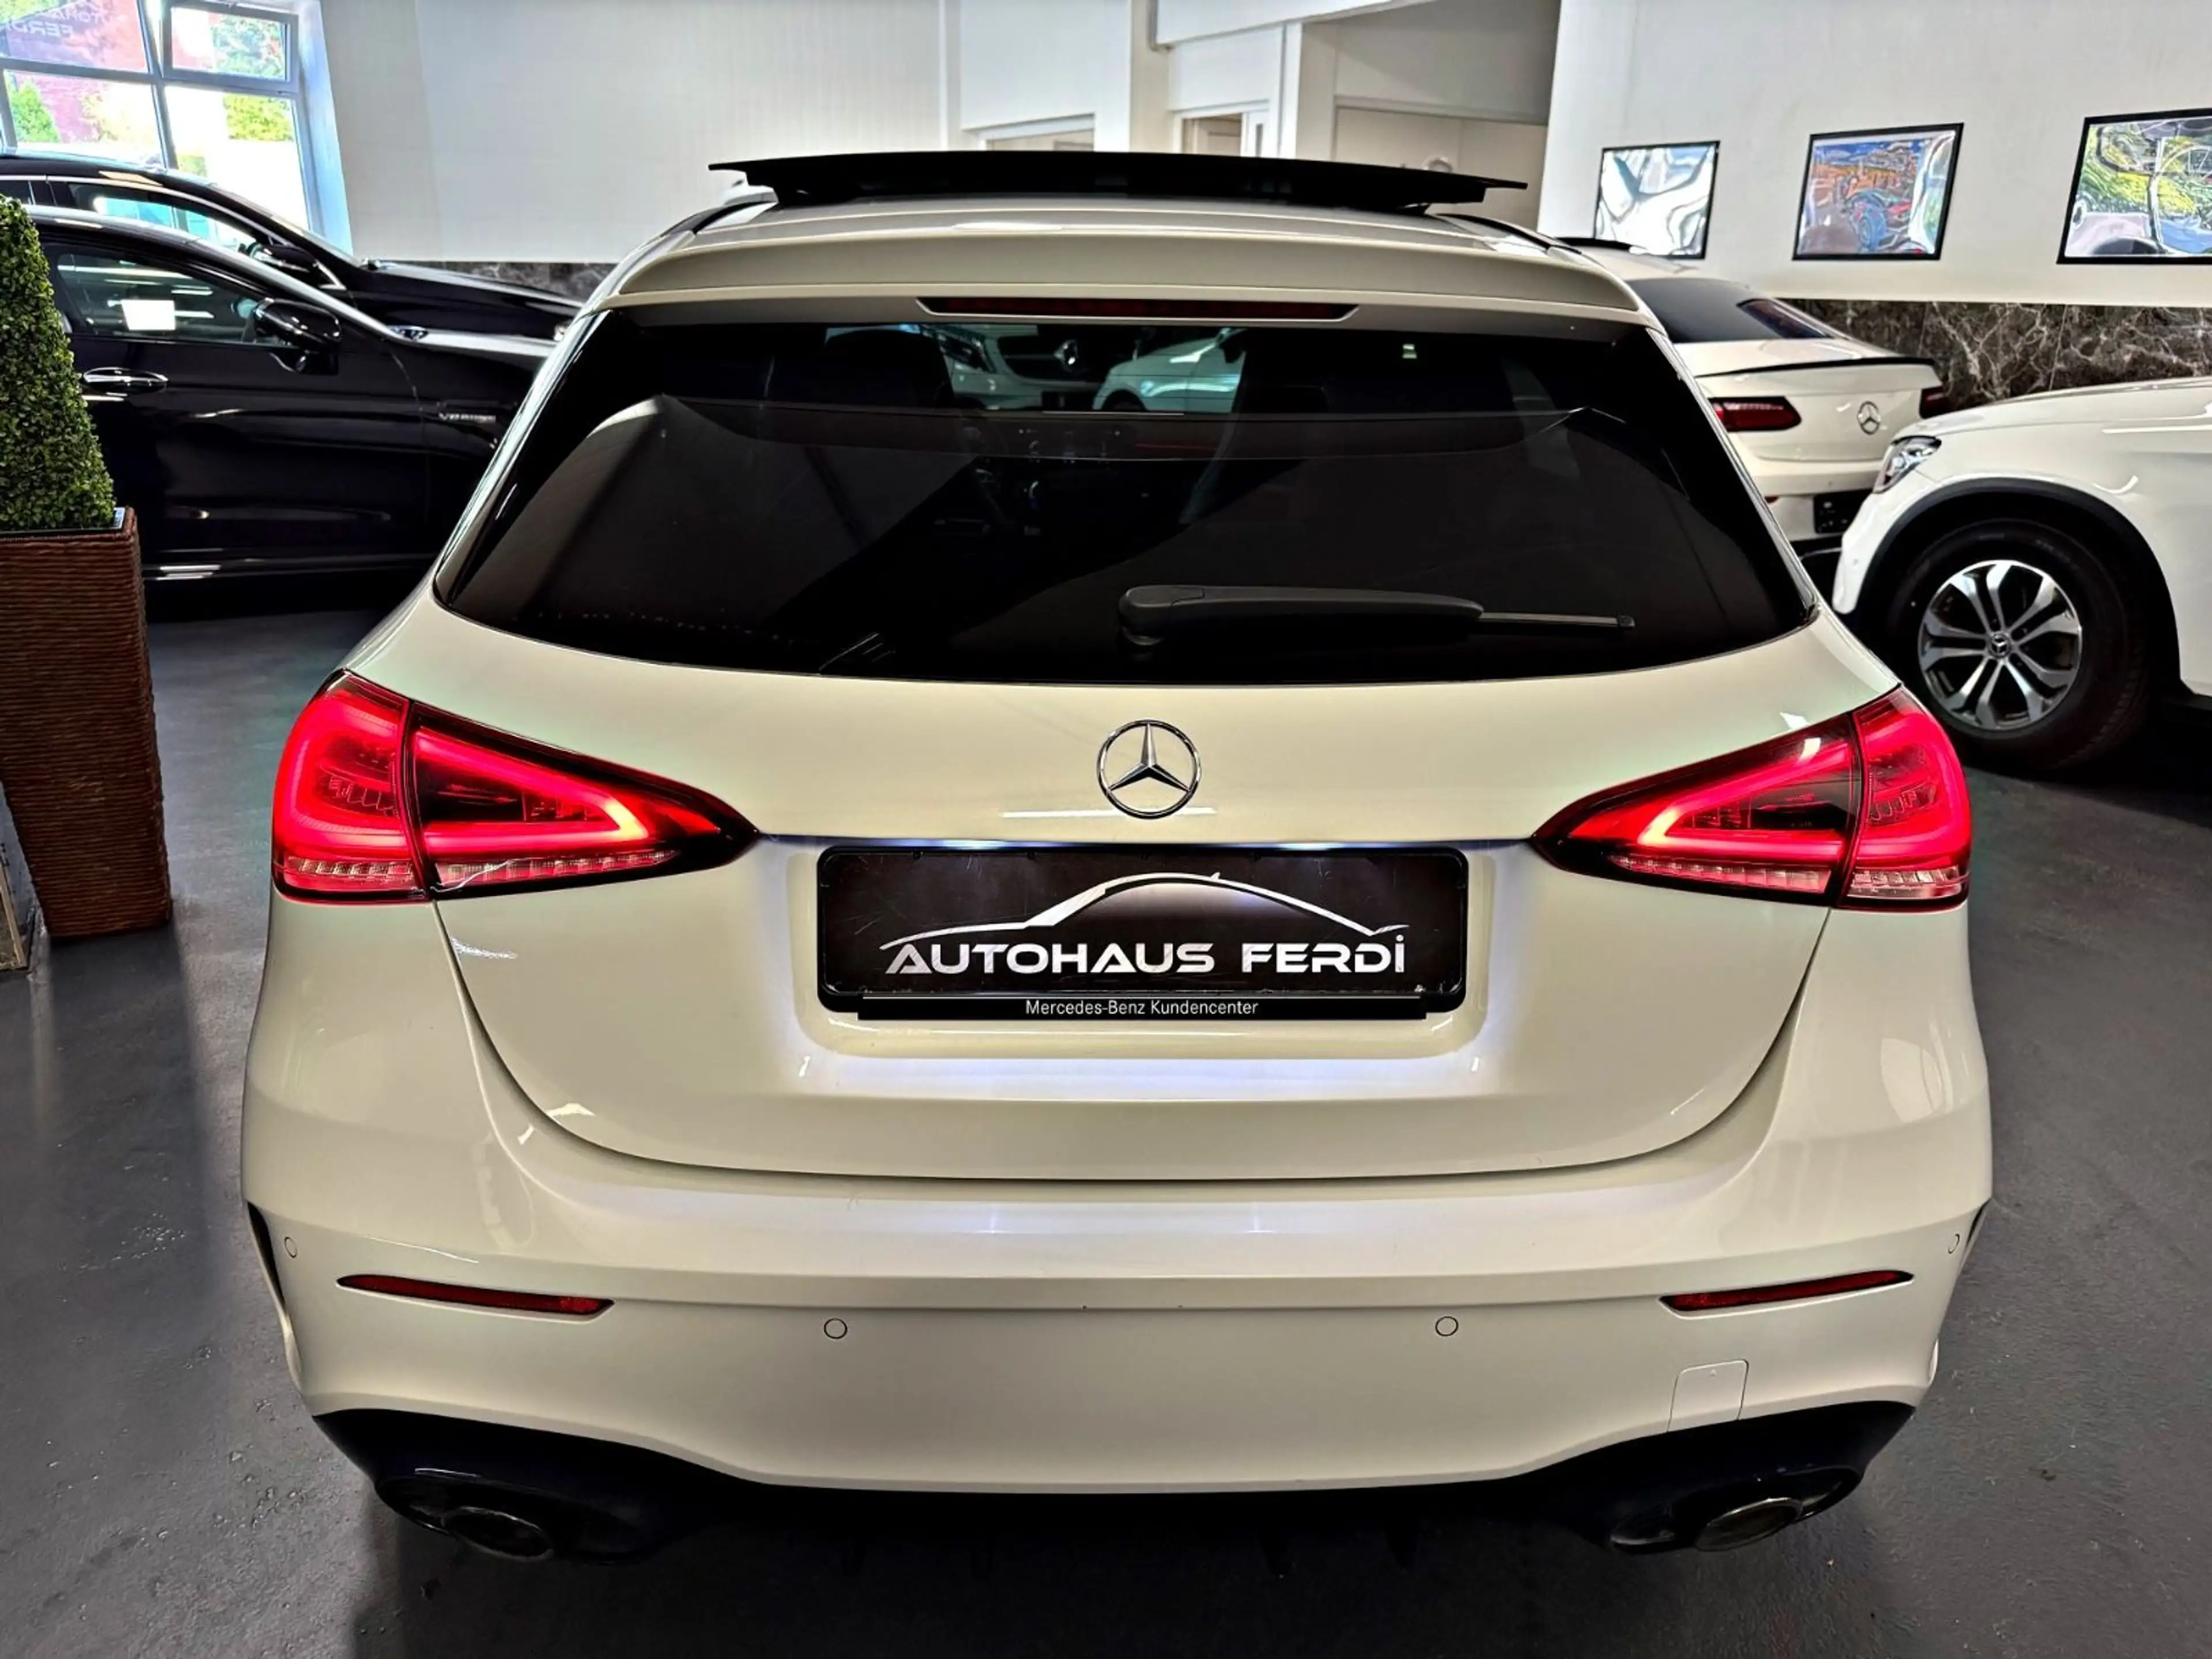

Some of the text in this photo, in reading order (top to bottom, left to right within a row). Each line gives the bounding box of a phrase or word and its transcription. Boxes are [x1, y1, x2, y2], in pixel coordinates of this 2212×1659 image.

[885, 943, 1215, 974] AUTOHAUS
[1026, 999, 1259, 1014] Mercedes-Benz Kundencenter
